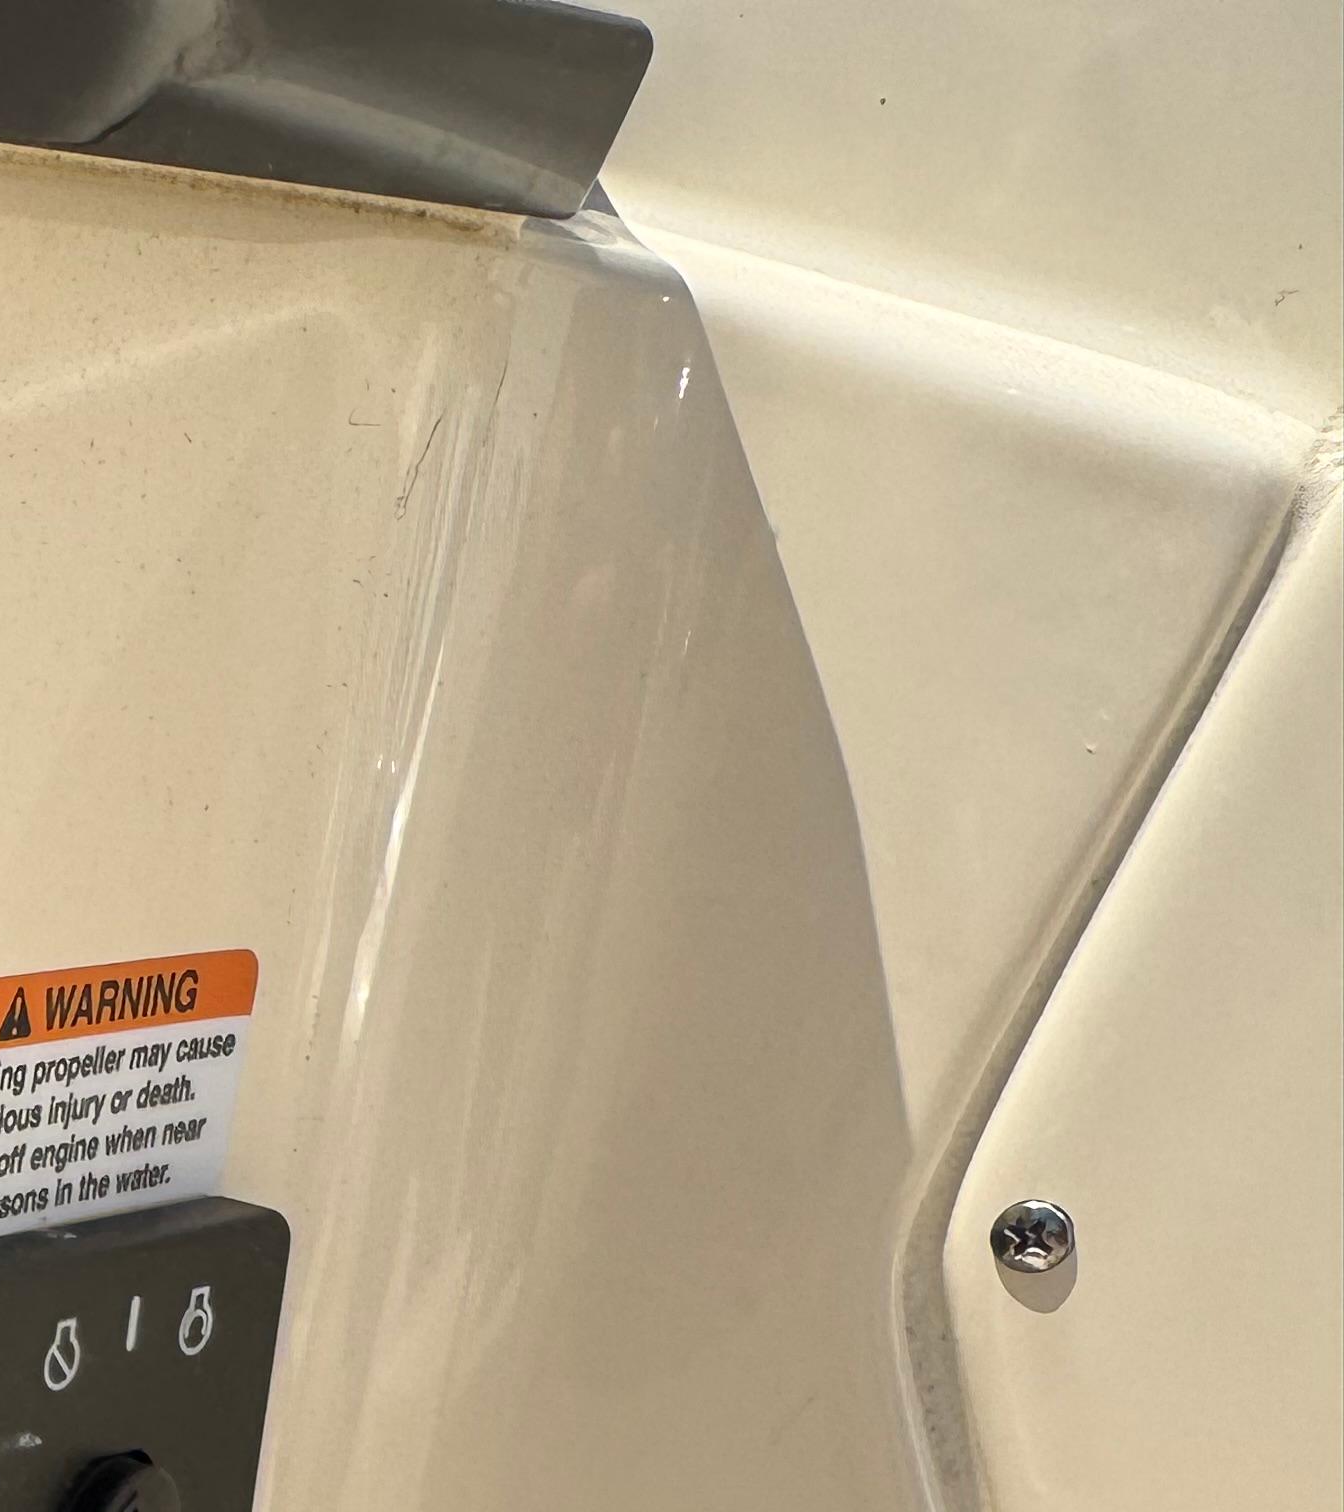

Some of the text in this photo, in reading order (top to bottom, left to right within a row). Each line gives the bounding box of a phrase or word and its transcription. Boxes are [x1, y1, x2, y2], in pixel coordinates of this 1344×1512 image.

[45, 969, 199, 1031] WARNING
[31, 1045, 126, 1094] propeller
[129, 1042, 173, 1073] may
[176, 1033, 236, 1063] cause
[47, 1092, 107, 1130] injury
[110, 1089, 134, 1115] or
[136, 1074, 196, 1110] death.
[30, 1133, 100, 1174] engine
[105, 1124, 158, 1157] when
[161, 1117, 208, 1146] near
[54, 1178, 74, 1207] in
[78, 1171, 111, 1202] the
[116, 1162, 172, 1194] water.
